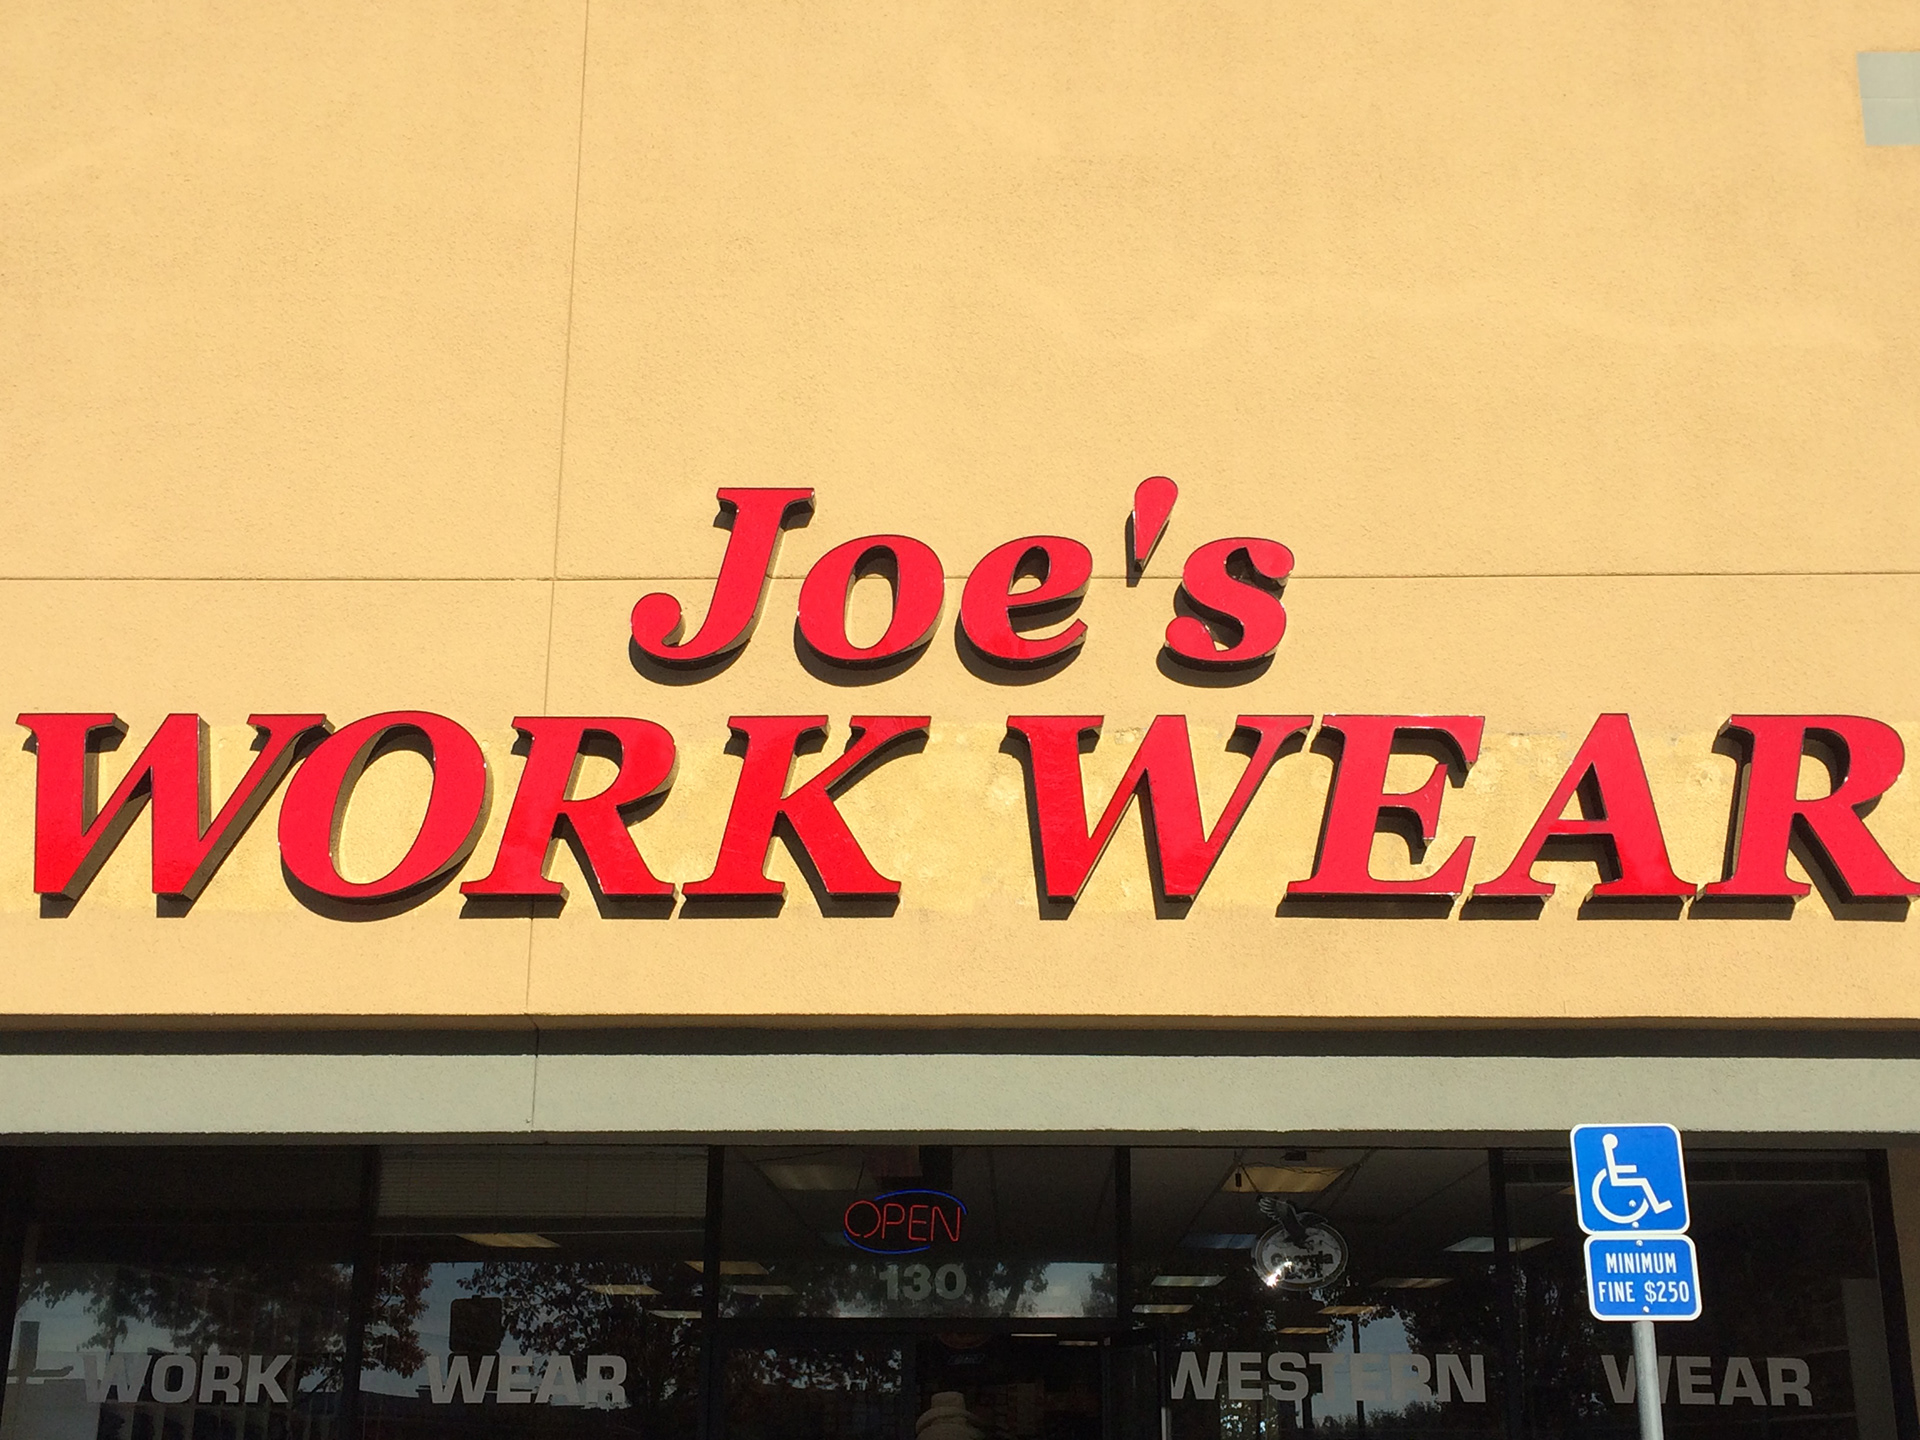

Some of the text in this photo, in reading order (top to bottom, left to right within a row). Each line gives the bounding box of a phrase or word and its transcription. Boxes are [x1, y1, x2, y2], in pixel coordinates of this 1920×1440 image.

[629, 476, 1295, 662] Joe's
[15, 711, 1920, 898] WORK WEAR
[844, 1199, 962, 1242] OPEN
[879, 1263, 967, 1300] 130
[1605, 1252, 1678, 1274] MINIMUM
[1598, 1280, 1690, 1305] FINE $250
[82, 1354, 628, 1404] WORK WEAR
[1170, 1351, 1813, 1407] WESTERN WEAR
